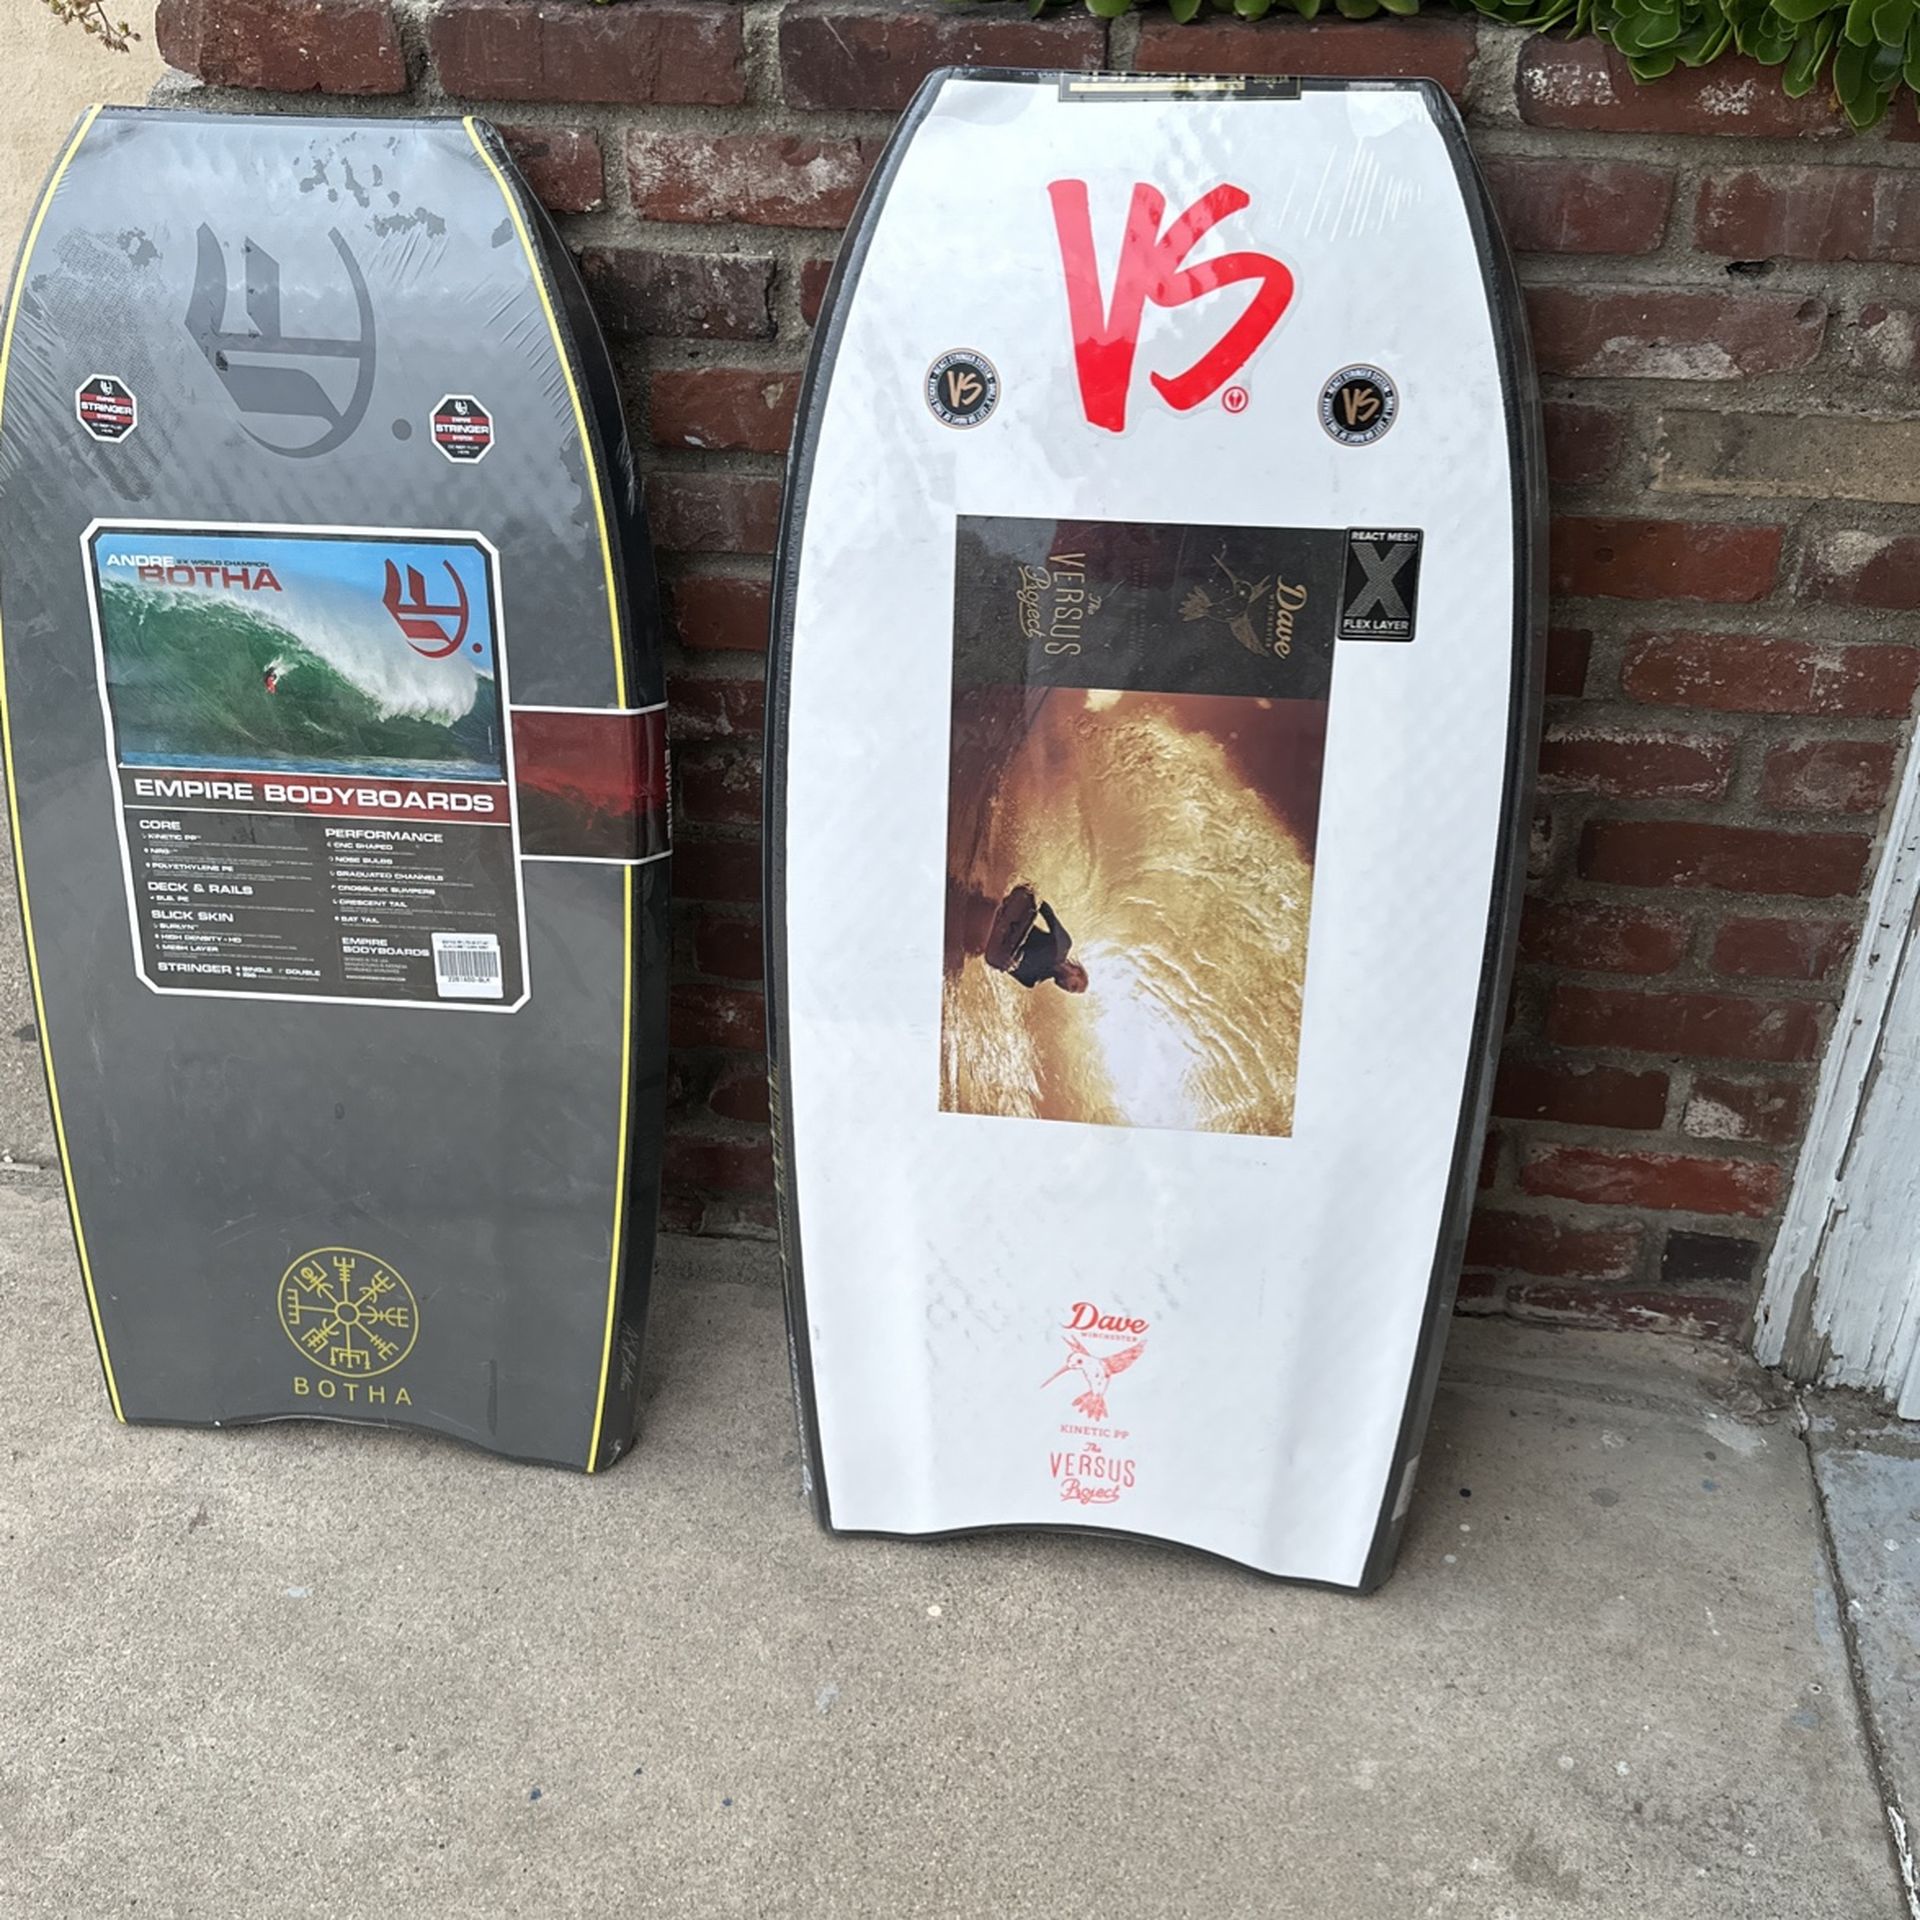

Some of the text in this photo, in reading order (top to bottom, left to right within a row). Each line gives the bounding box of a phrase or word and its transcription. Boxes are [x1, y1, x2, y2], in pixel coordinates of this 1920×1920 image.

[1047, 179, 1294, 432] VS
[947, 370, 983, 408] VS
[81, 401, 133, 415] STRINGER
[1342, 388, 1380, 426] VS
[436, 424, 489, 434] STRINGER
[1351, 531, 1418, 541] REACT MESH
[107, 554, 175, 568] ANDRE
[191, 559, 223, 567] WORLD
[224, 560, 269, 568] CHAMPION
[138, 565, 283, 592] BOTHA
[1344, 542, 1418, 618] X
[1018, 565, 1051, 639] Project
[1045, 552, 1086, 656] VERSUS
[1274, 575, 1307, 659] Dave
[1343, 619, 1409, 630] FLEX LAYER
[135, 779, 495, 812] EMPIRE BODYBOARDS
[139, 819, 182, 831] CORE
[324, 828, 444, 843] PERFORMANCE
[356, 843, 393, 851] SHAPED
[152, 862, 220, 872] POLYETHYLENE
[335, 856, 361, 864] NOSE
[336, 870, 444, 882] GRADUATED CHANNELS
[148, 881, 254, 895] DECK & RAILS
[389, 900, 408, 908] TAIL
[151, 909, 234, 922] SLICK SKIN
[361, 916, 380, 924] TAIL
[342, 937, 388, 947] EMPIRE
[343, 946, 430, 957] BODYBOARDS
[157, 962, 232, 974] STRINGER
[285, 968, 321, 977] DOUBLE
[1060, 1302, 1150, 1334] Dave
[1081, 1332, 1138, 1342] WINCHESTER
[294, 1376, 412, 1405] BOTHA
[1060, 1424, 1130, 1439] KINETIC PP
[1083, 1442, 1102, 1452] The
[1050, 1452, 1136, 1488] VERSUS
[1060, 1478, 1120, 1505] Project
